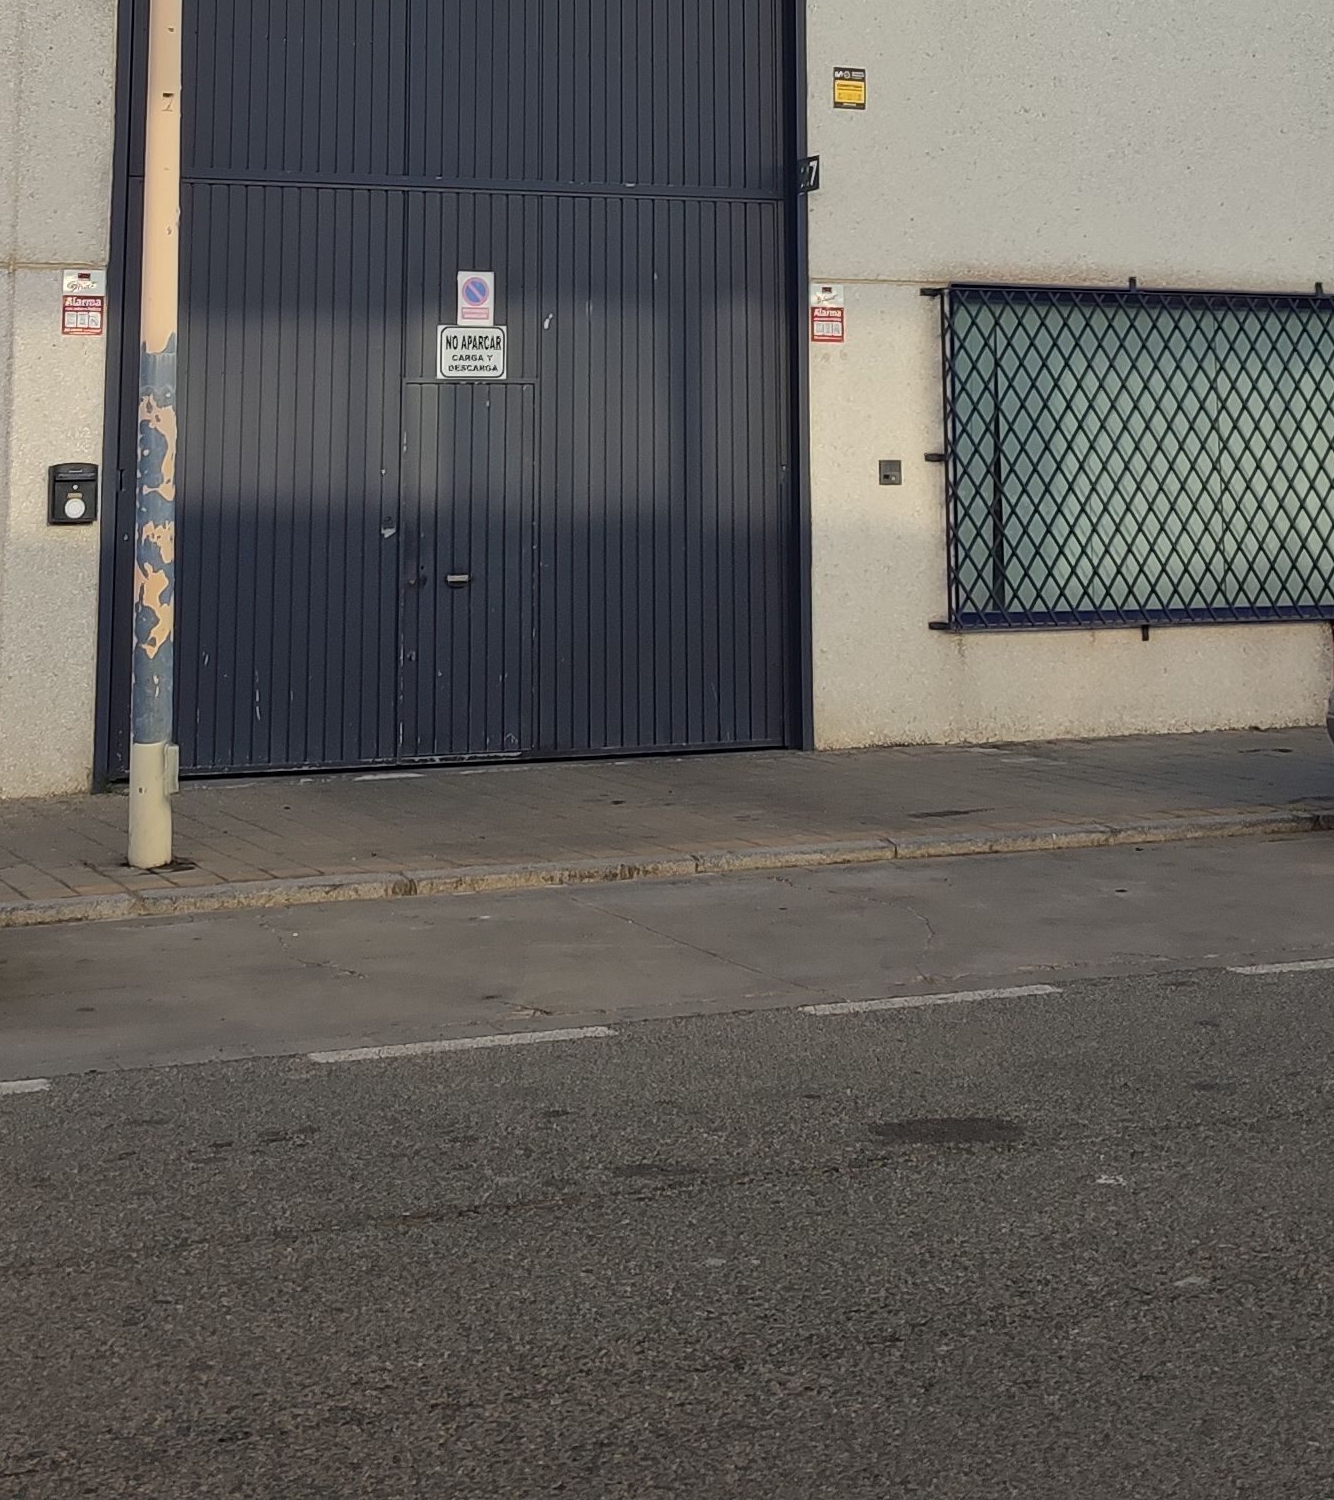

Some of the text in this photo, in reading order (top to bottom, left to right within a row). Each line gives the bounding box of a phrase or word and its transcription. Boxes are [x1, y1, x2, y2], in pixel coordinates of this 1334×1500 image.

[445, 335, 502, 350] NO APARCAR
[451, 354, 484, 362] CARGA
[448, 364, 499, 372] DESCARGA
